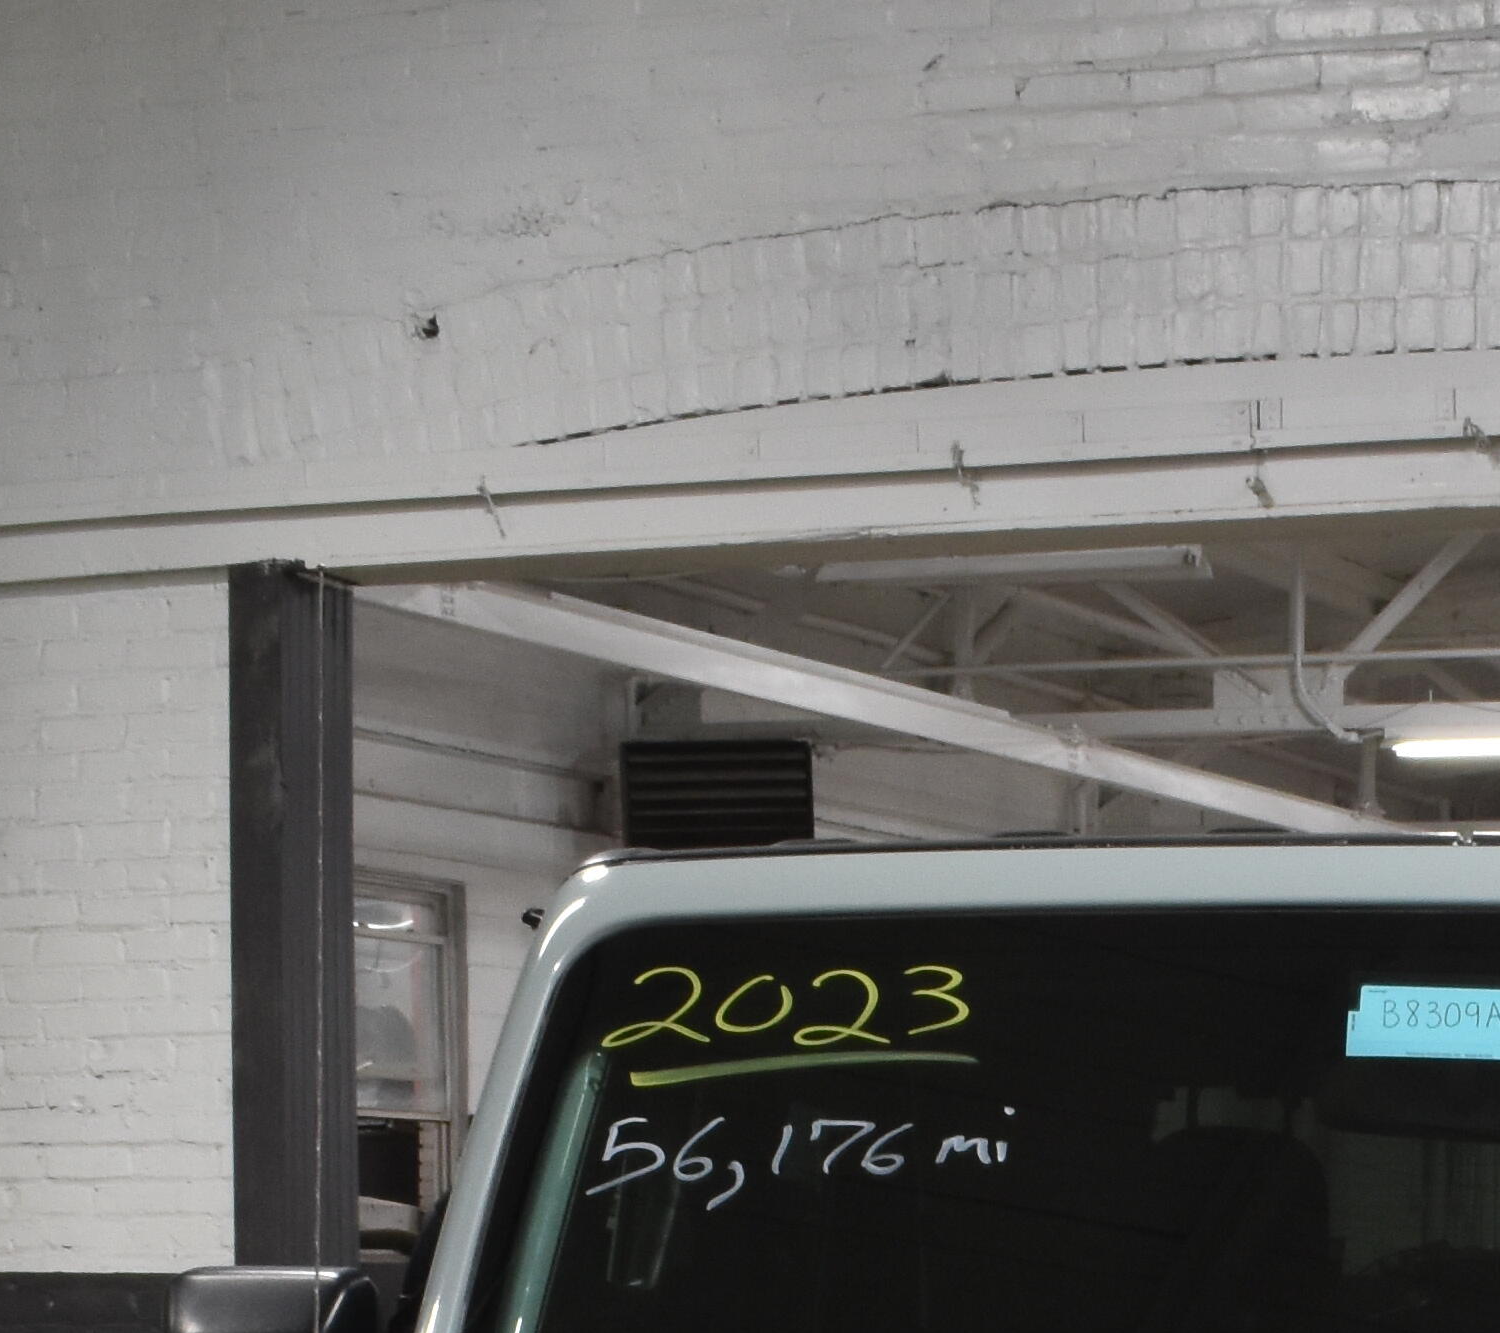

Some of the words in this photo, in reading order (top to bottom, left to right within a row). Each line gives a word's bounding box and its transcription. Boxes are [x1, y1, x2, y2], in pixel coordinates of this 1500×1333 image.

[601, 965, 970, 1048] 2023
[586, 1116, 914, 1210] 56,176
[937, 1105, 1016, 1165] mi
